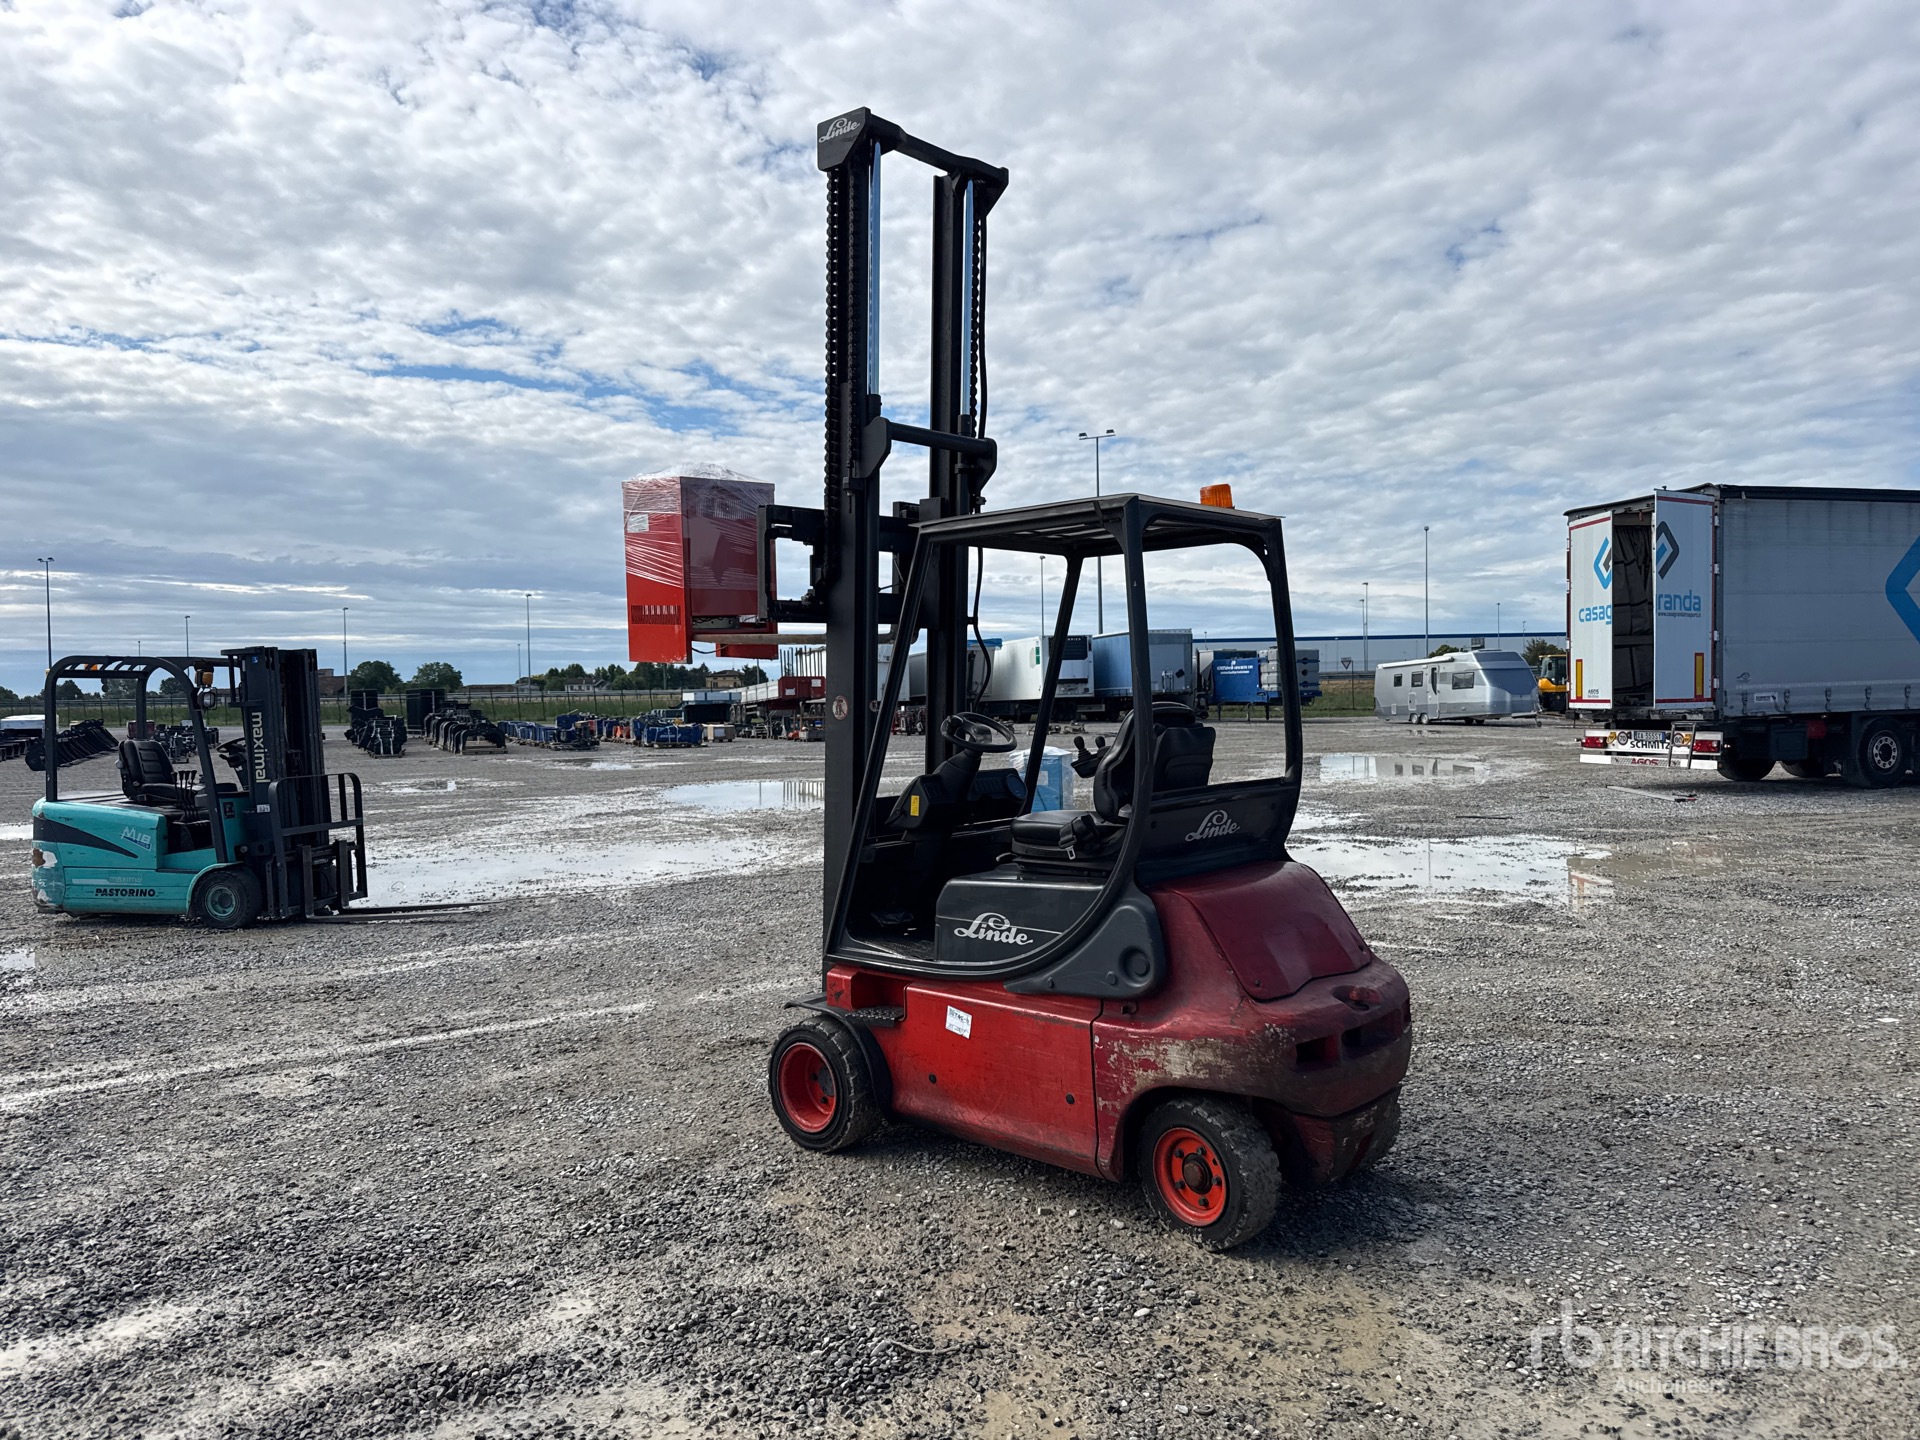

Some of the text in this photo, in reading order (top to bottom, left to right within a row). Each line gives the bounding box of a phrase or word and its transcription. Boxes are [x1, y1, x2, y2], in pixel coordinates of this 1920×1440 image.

[819, 117, 861, 143] Linde
[251, 711, 271, 783] maximal
[1630, 740, 1671, 750] SCHMITZ
[1184, 809, 1240, 842] Linde
[95, 888, 156, 897] PASTORINO
[953, 912, 1034, 945] Linde
